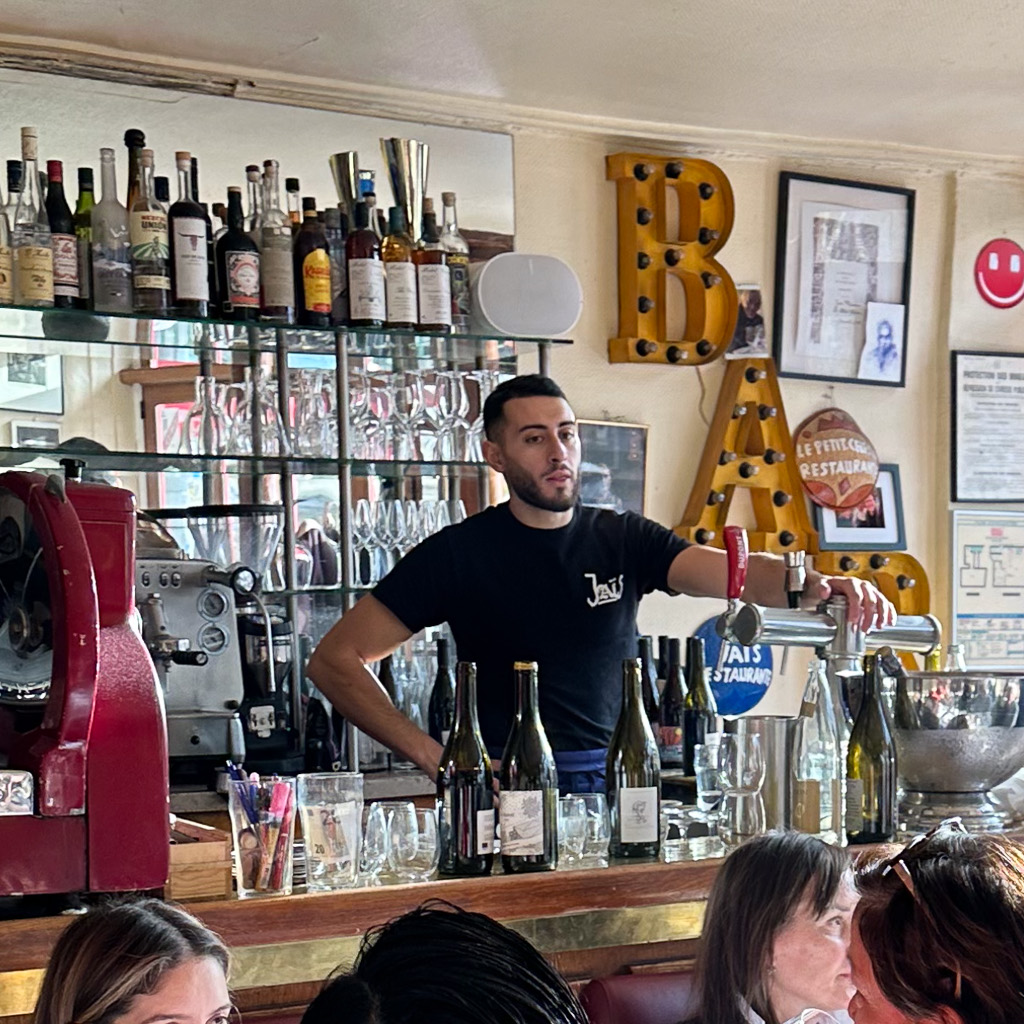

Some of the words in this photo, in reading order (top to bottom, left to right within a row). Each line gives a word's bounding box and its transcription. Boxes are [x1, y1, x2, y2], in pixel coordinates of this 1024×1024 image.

[796, 442, 814, 458] LE
[737, 535, 746, 569] DUPONT
[703, 666, 772, 687] ESTAURANT
